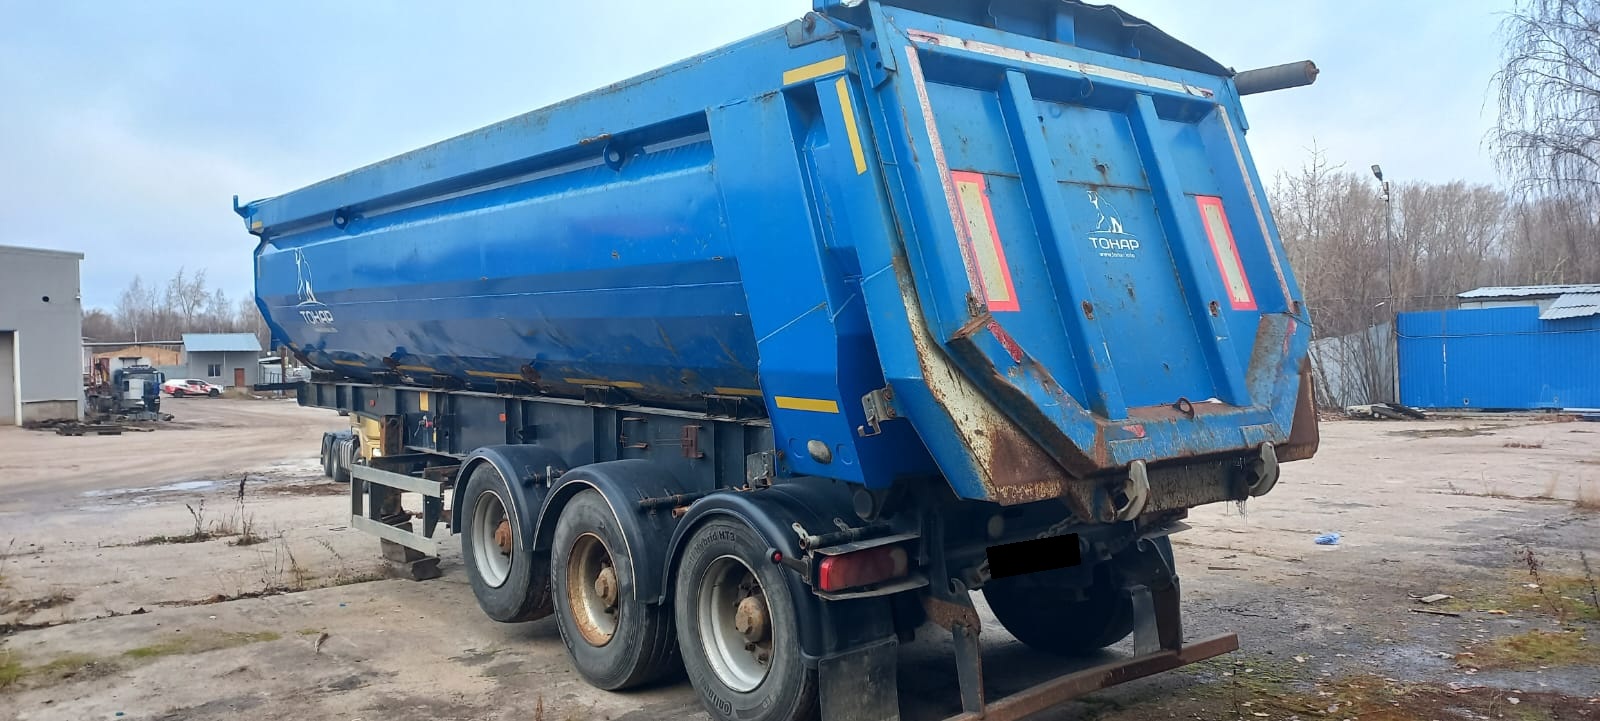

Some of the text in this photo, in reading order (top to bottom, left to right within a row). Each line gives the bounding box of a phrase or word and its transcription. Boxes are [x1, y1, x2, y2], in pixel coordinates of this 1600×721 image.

[1088, 237, 1139, 250] ТОНАР
[299, 310, 334, 325] ТОНАР
[694, 531, 718, 553] Hybrid
[719, 531, 736, 542] HT3
